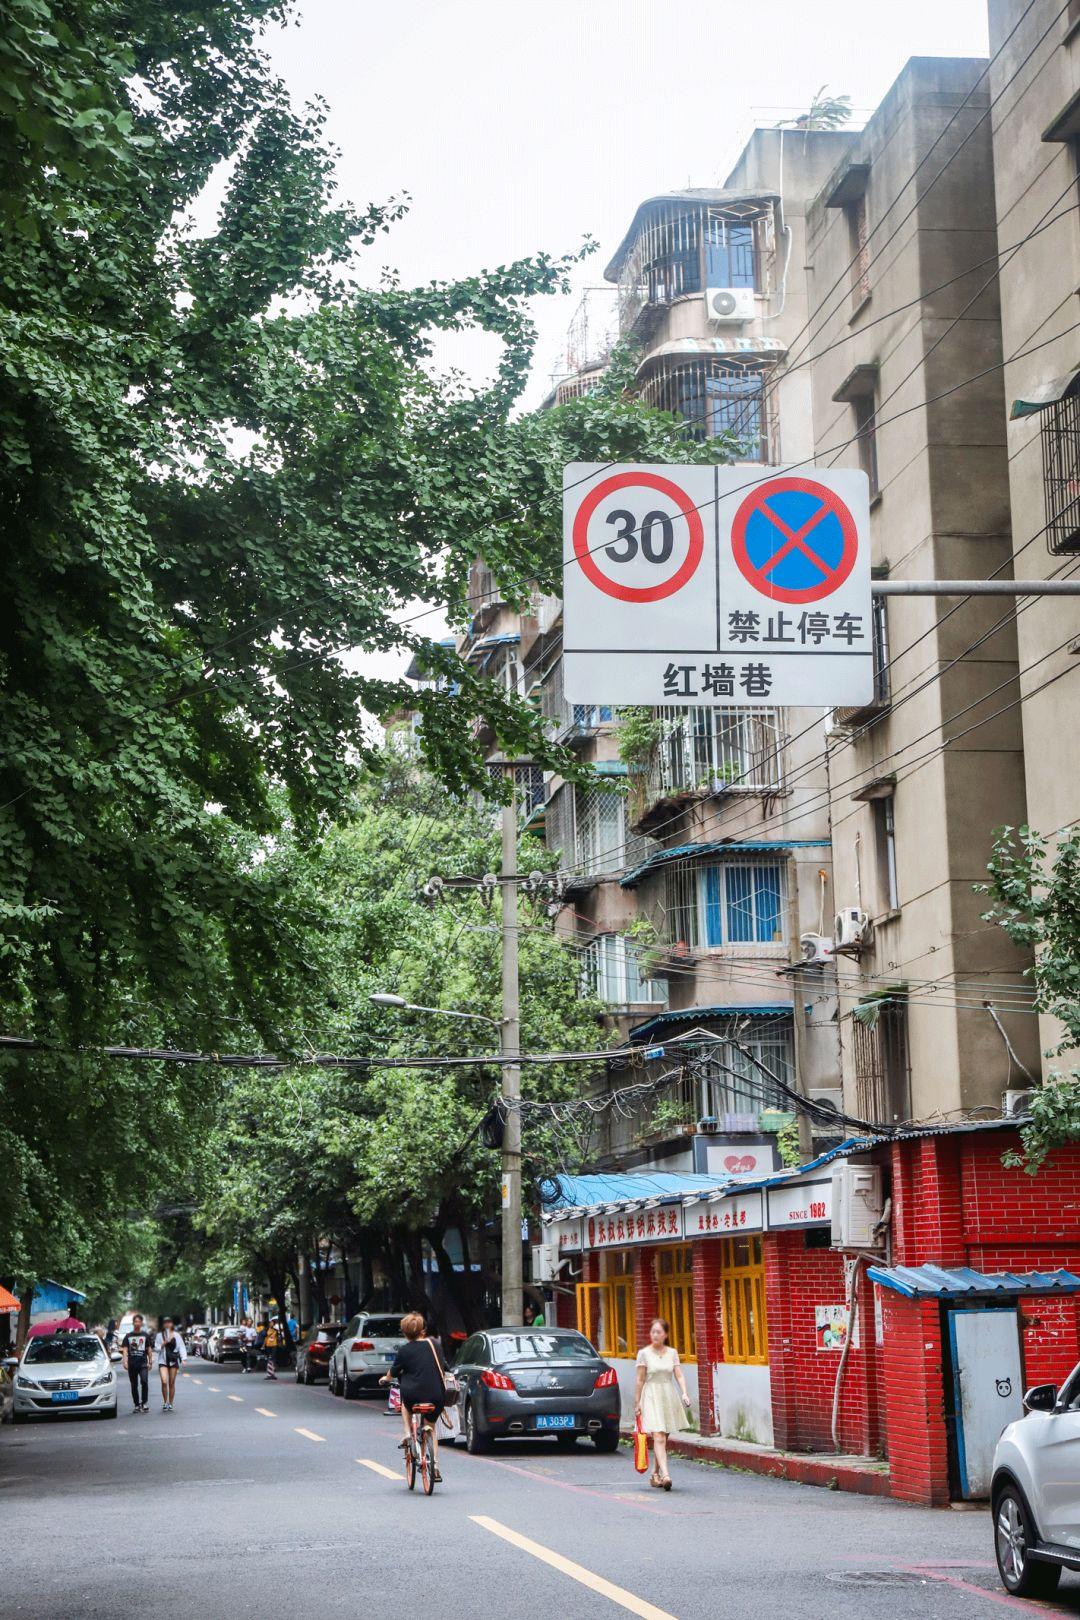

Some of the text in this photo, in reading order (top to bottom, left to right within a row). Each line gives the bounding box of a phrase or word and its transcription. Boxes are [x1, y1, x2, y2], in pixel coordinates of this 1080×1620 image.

[604, 509, 674, 564] 30
[727, 609, 865, 645] 禁止停车
[662, 662, 773, 698] 红墙巷
[788, 1201, 826, 1221] SINCE 1982
